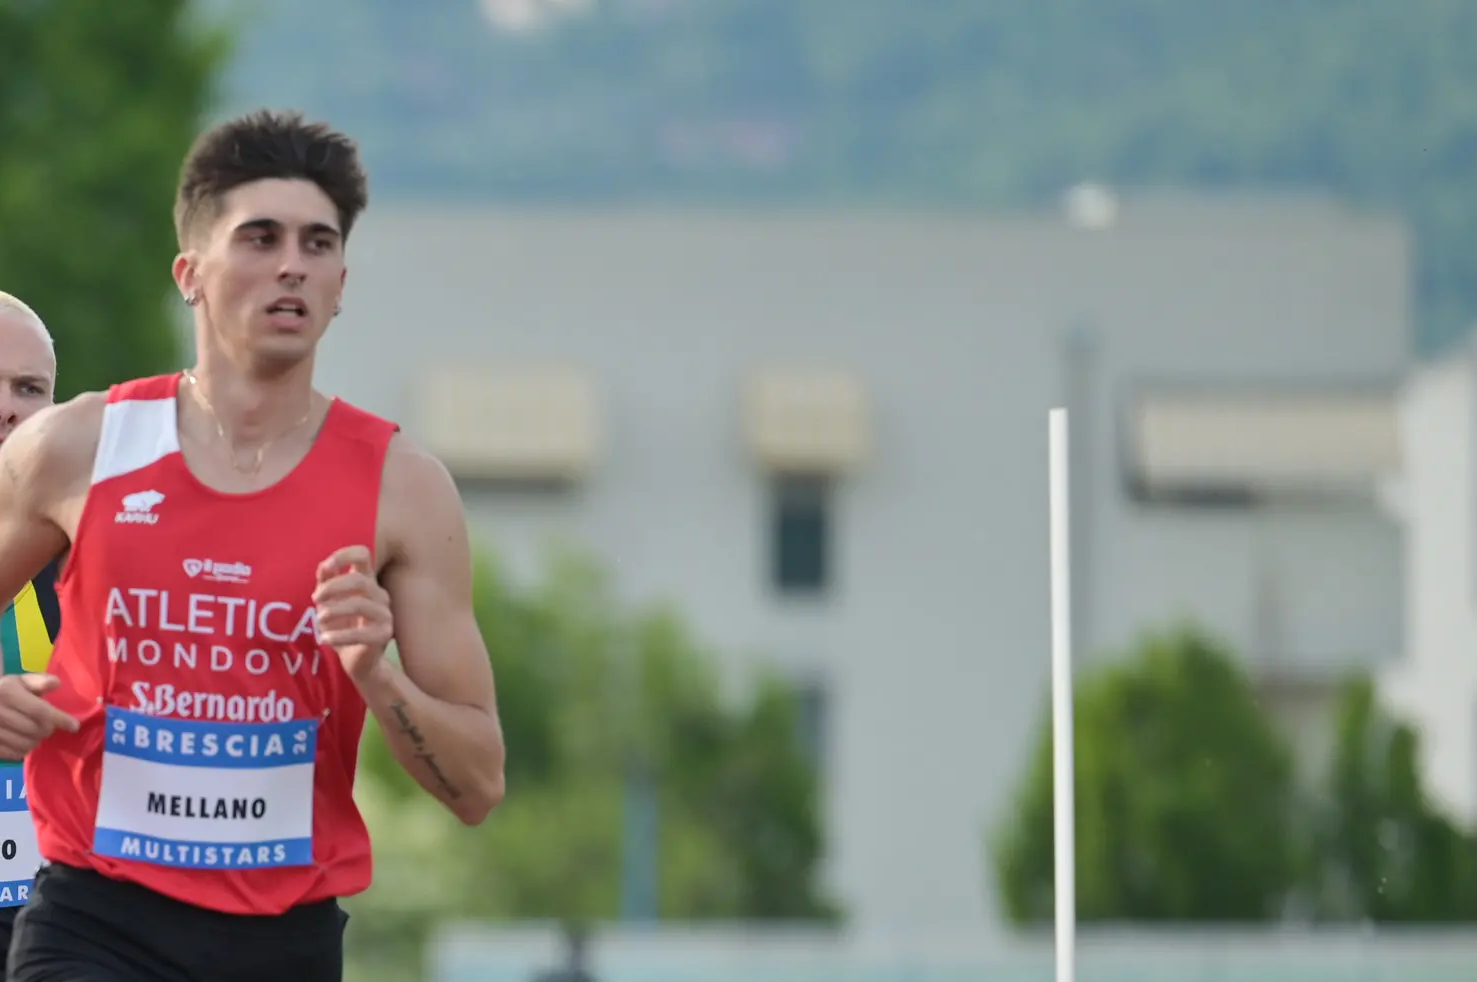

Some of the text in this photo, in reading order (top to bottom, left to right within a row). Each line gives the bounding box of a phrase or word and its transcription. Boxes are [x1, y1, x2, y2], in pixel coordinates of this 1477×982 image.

[105, 587, 322, 645] ATLETICA
[134, 725, 284, 757] BRESCIA
[146, 791, 267, 819] MELLANO
[121, 836, 287, 863] MULTISTARS
